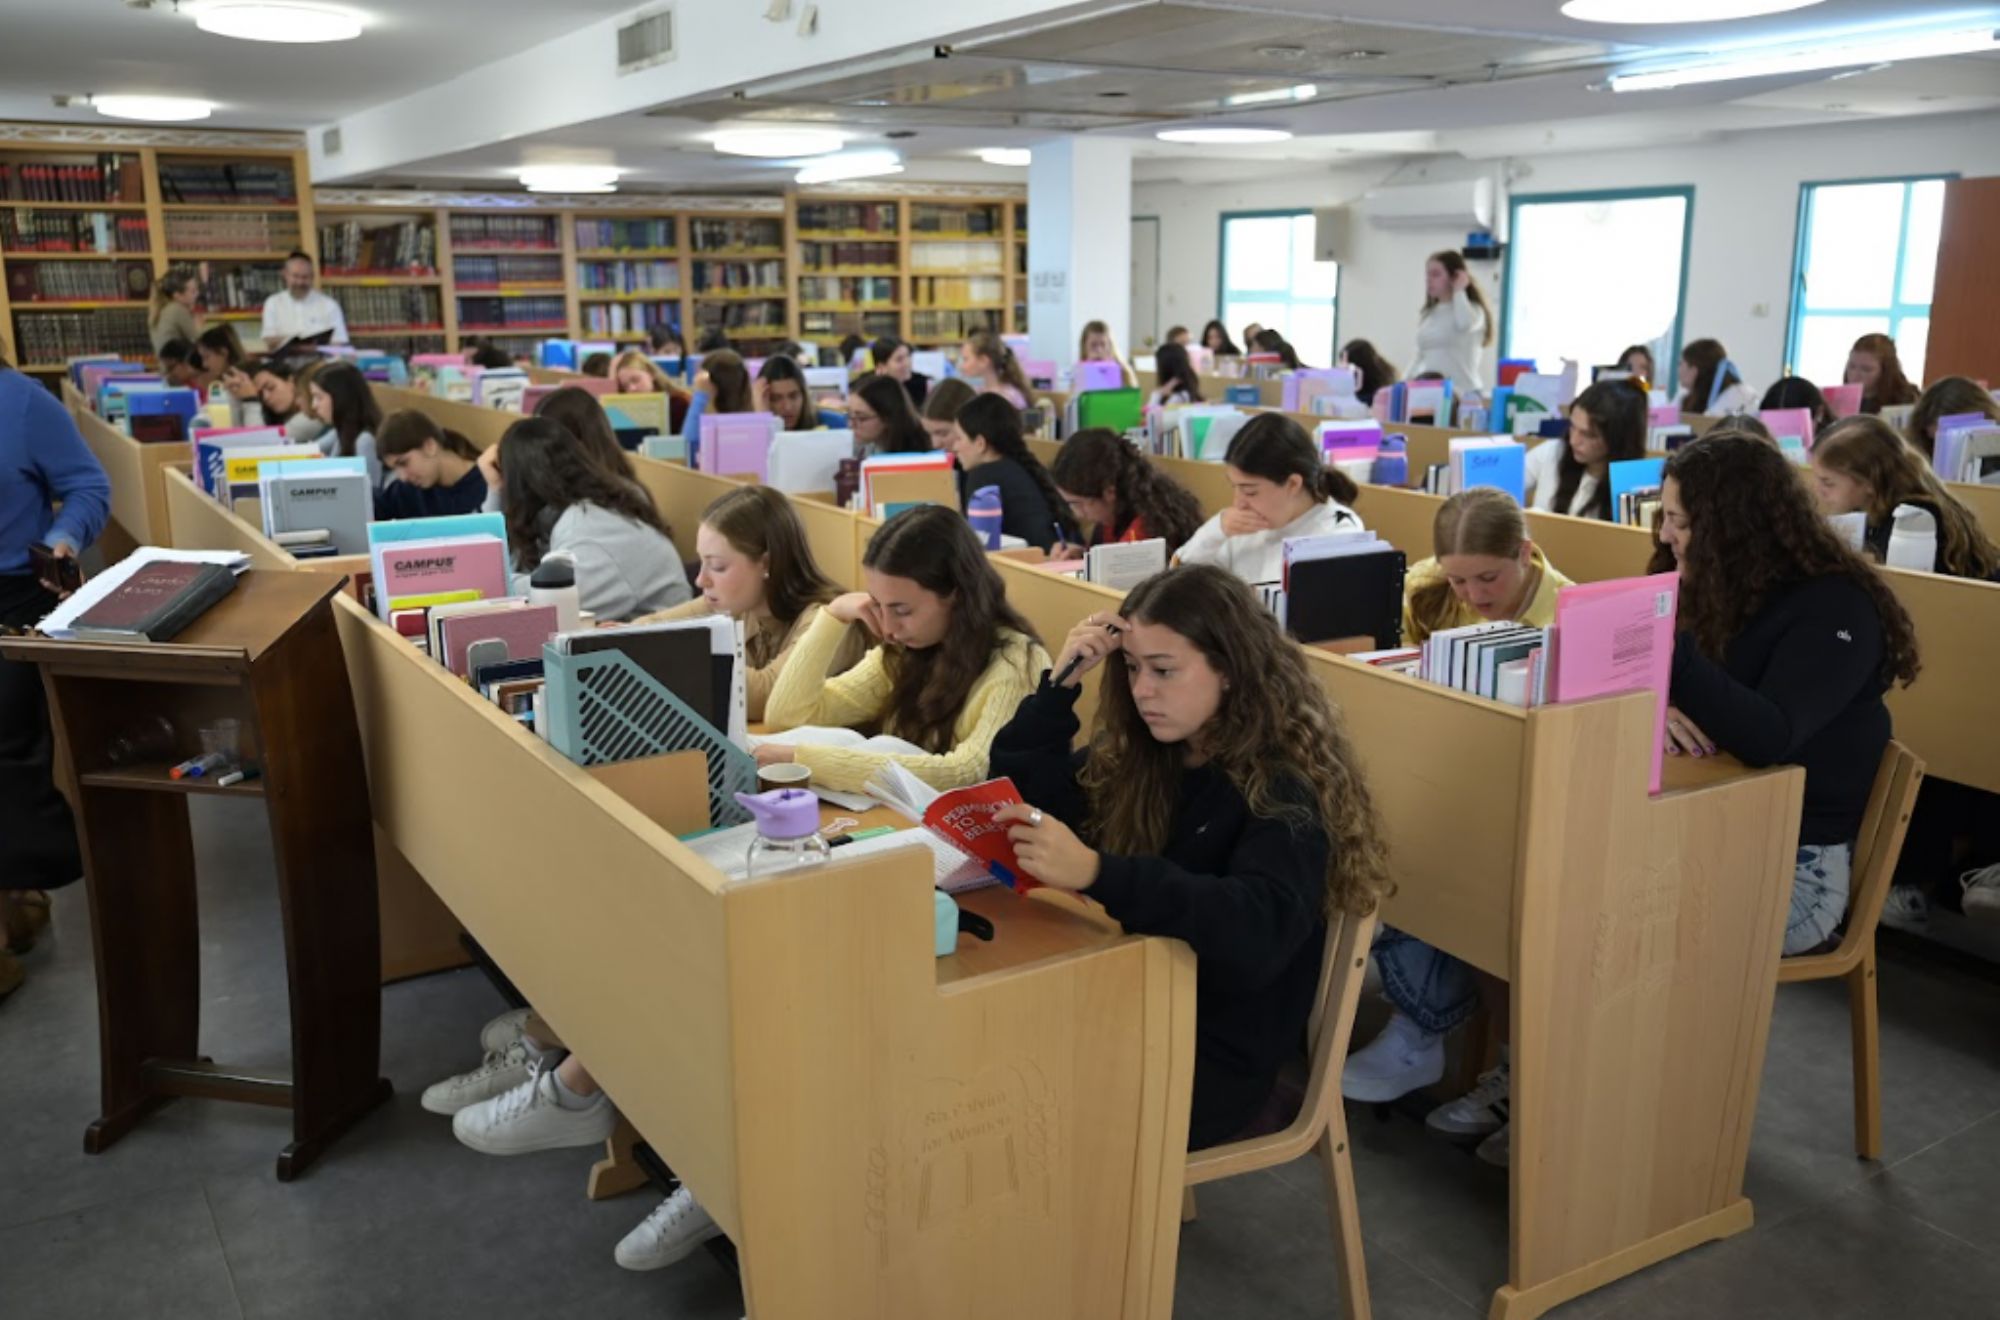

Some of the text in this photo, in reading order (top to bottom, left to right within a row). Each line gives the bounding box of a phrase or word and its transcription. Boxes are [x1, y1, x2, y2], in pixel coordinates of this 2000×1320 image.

[235, 465, 258, 476] CAM
[290, 486, 337, 498] CAMPUS
[394, 556, 455, 571] CAMPUS
[952, 817, 975, 832] TO
